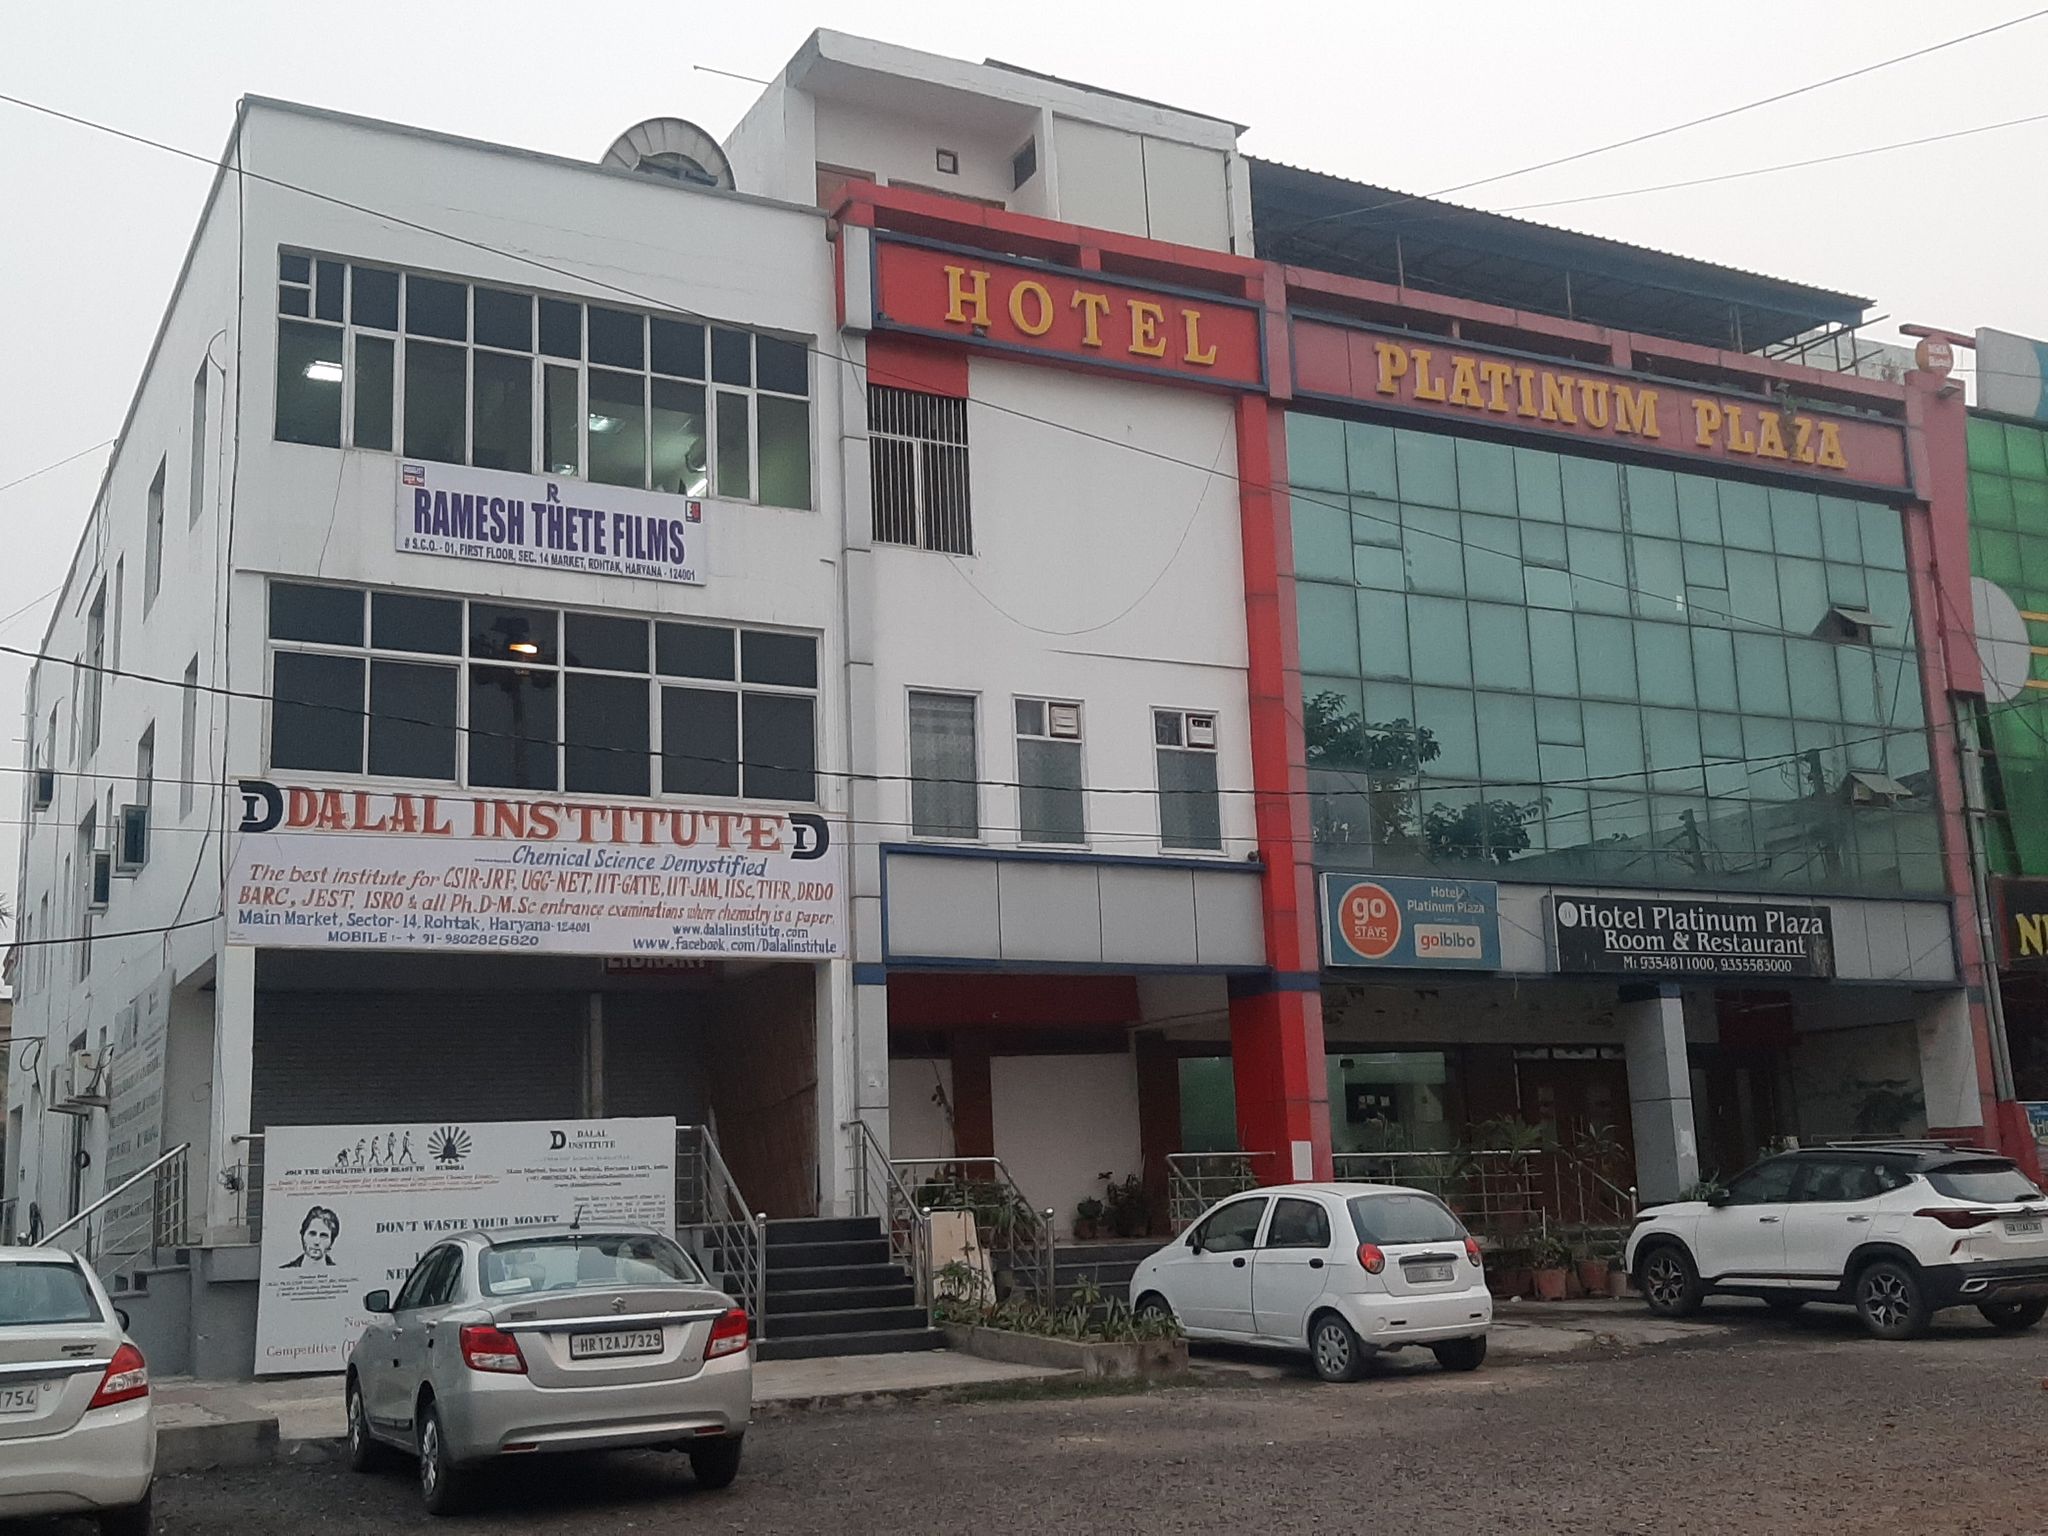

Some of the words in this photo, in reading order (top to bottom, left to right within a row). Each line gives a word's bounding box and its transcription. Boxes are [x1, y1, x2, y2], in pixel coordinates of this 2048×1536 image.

[943, 264, 1218, 366] HOTEL
[1375, 341, 1662, 440] PLATINUM
[1692, 398, 1848, 470] PLAZA
[546, 483, 560, 503] R
[414, 488, 524, 546] RAMESH
[531, 502, 607, 556] THETE
[613, 512, 685, 565] FILMS
[459, 543, 484, 558] FIRST
[518, 549, 537, 563] SEC.
[540, 552, 549, 565] 14
[550, 554, 587, 570] MARKET,
[625, 562, 662, 578] HARYANA
[284, 785, 454, 837] DALAL
[471, 798, 785, 854] INSTITUTE
[513, 845, 589, 867] Chemical
[594, 850, 656, 870] Science
[660, 853, 768, 877] Demystified
[250, 863, 285, 882] The
[289, 865, 329, 883] best
[333, 867, 407, 886] institute
[407, 869, 440, 891] for
[1431, 885, 1461, 898] Hotel
[363, 890, 404, 910] ISRO
[407, 894, 417, 910] &
[422, 893, 446, 912] all
[539, 898, 602, 916] entrance
[607, 900, 684, 919] examinations
[718, 902, 771, 926] chemistry
[1352, 897, 1387, 925] go
[1407, 899, 1455, 914] Platinum
[1457, 902, 1486, 914] Plaza
[1578, 903, 1644, 930] Hotel
[1651, 905, 1757, 933] Platinum
[1764, 910, 1824, 935] Plaza
[238, 909, 281, 926] Main
[284, 910, 343, 927] Market,
[424, 915, 485, 932] Rohtak,
[1354, 926, 1388, 938] STAYS
[327, 931, 388, 943] MOBILE
[1420, 931, 1476, 950] goibibo
[1604, 928, 1665, 951] Room
[1672, 931, 1690, 951] &
[1697, 931, 1807, 955] Restaurant
[376, 1221, 418, 1233] DON'T
[423, 1218, 468, 1231] WASTE
[472, 1217, 509, 1229] YOUR
[266, 1343, 337, 1359] Competitive
